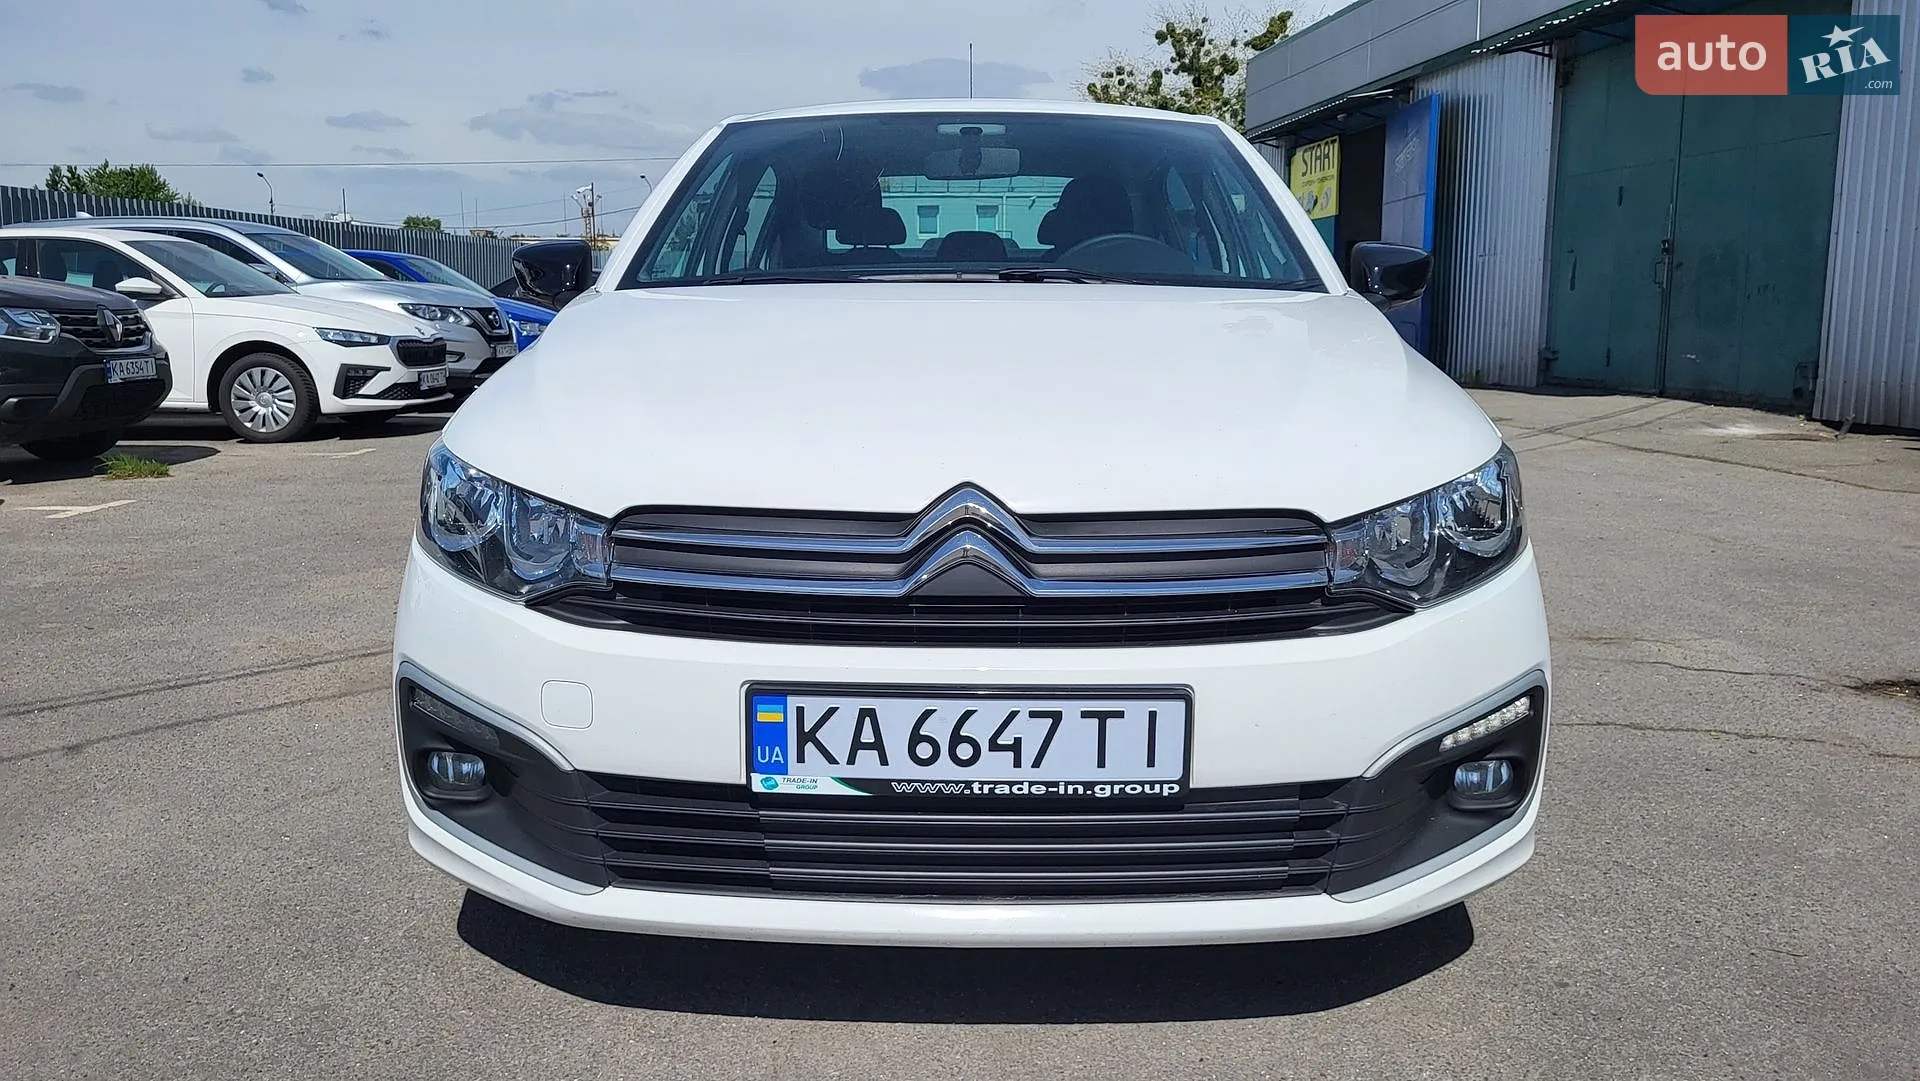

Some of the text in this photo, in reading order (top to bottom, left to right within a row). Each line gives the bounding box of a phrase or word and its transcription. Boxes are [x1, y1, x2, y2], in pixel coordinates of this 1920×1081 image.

[1301, 138, 1338, 177] START
[111, 362, 125, 377] KA
[126, 361, 144, 375] 6354
[795, 705, 1157, 769] KA 6647 TI
[757, 745, 785, 764] UA
[891, 781, 1181, 797] www.trade-in.group
